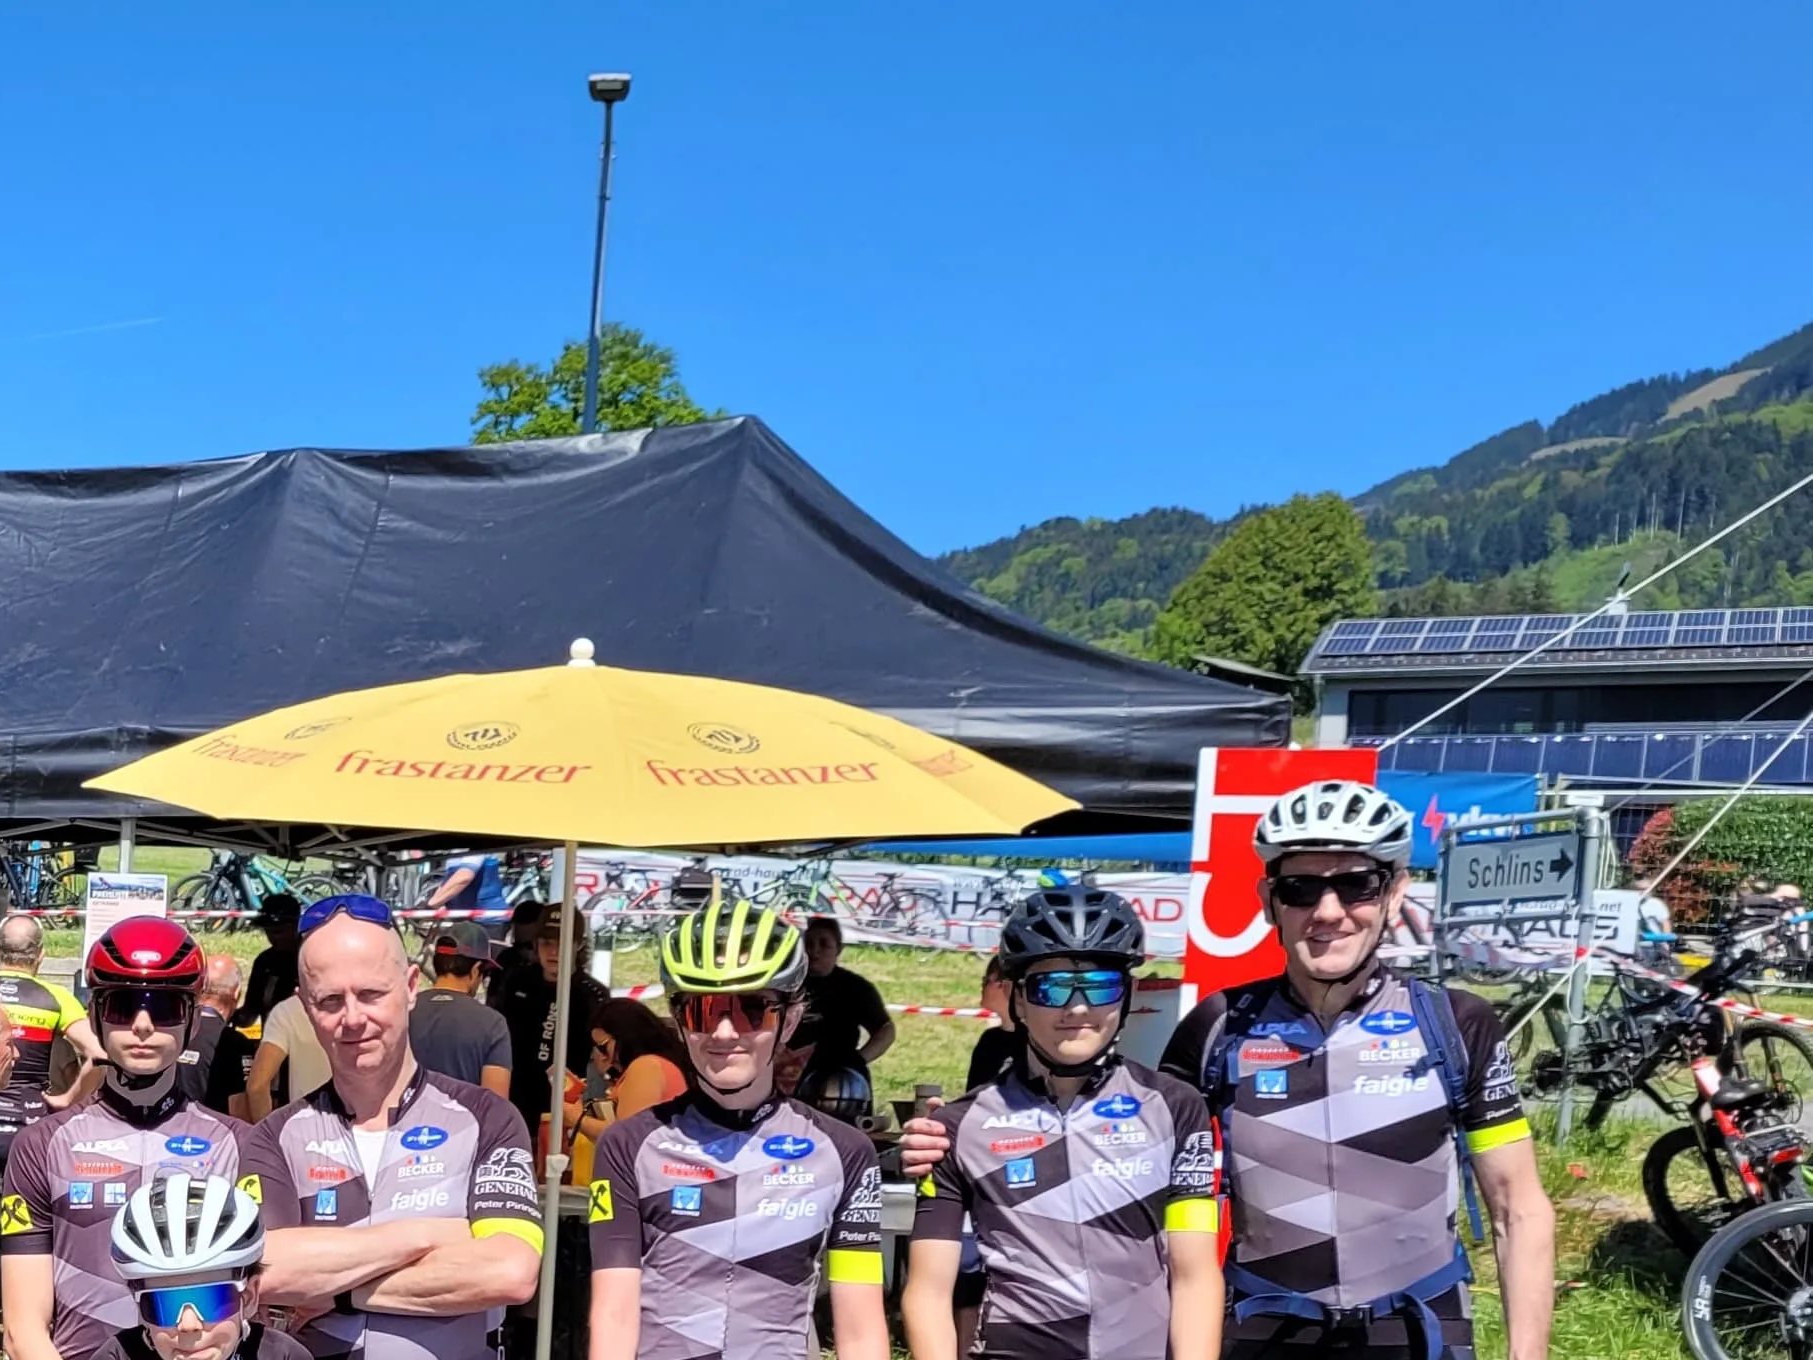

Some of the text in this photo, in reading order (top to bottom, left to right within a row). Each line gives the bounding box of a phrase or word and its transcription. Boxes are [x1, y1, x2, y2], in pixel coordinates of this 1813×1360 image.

[334, 749, 593, 784] frastanzer
[645, 759, 880, 787] frastanzer
[1467, 853, 1544, 889] Schlins
[1358, 1047, 1420, 1062] BECKER
[1352, 1074, 1430, 1096] faigle
[71, 1140, 130, 1152] ALPLA
[1093, 1131, 1147, 1145] BECKER
[397, 1162, 445, 1179] BECKER
[762, 1173, 815, 1185] BECKER
[1090, 1157, 1154, 1180] faigle
[390, 1189, 450, 1213] faigle
[474, 1200, 504, 1212] Peter
[756, 1198, 818, 1221] faigle
